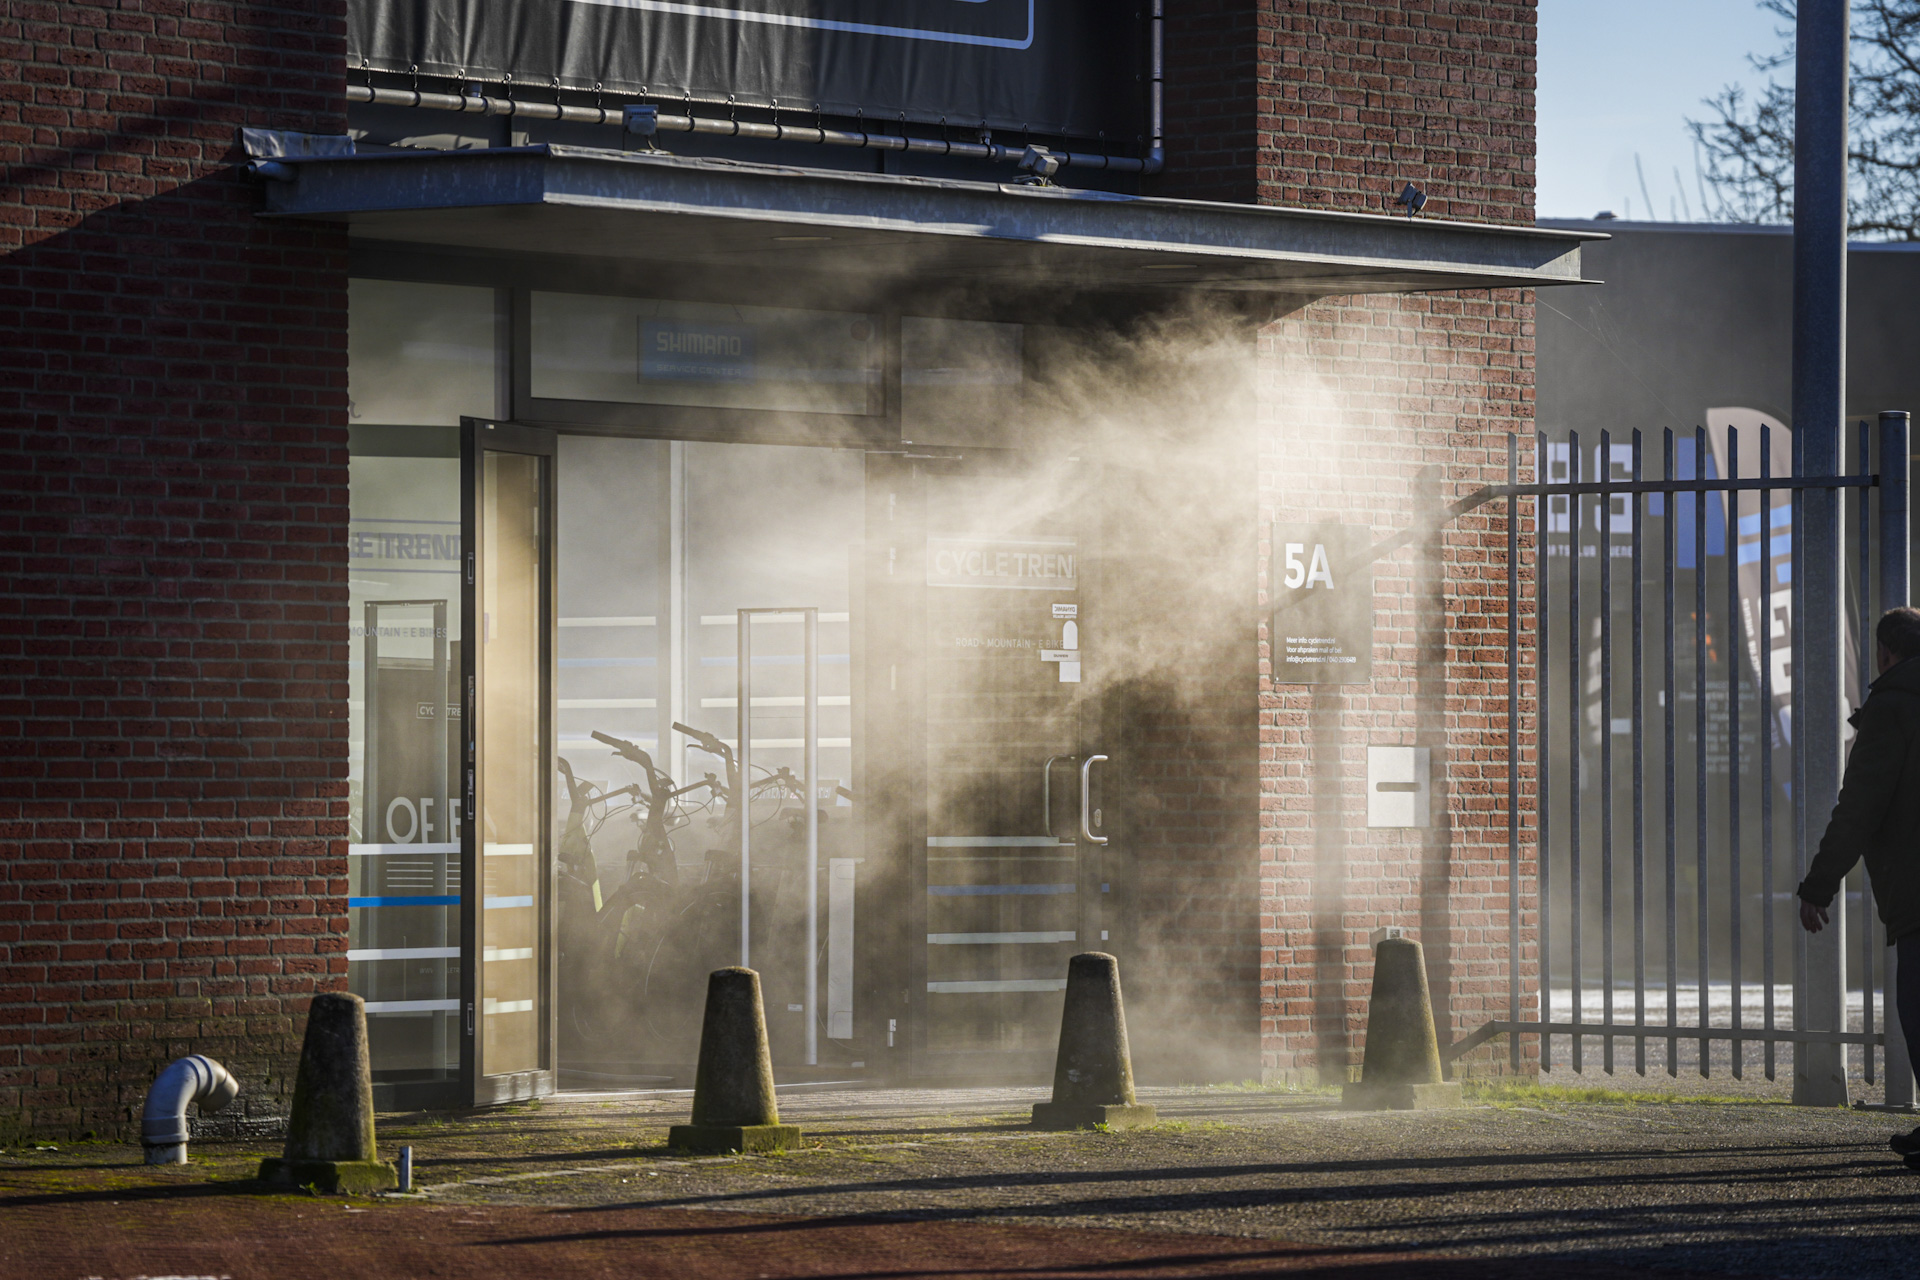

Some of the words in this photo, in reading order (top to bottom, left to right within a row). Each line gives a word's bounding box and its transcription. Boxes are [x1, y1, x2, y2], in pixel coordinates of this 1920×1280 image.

[656, 331, 742, 357] SHIMANO
[656, 364, 697, 374] SERVICE
[699, 366, 742, 377] CENTER
[935, 551, 1009, 577] CYCLE
[1284, 542, 1335, 590] 5A
[955, 637, 980, 648] ROAD
[987, 638, 1031, 649] MOUNTAIN
[1038, 639, 1044, 649] E
[1045, 639, 1064, 649] BIKE
[1286, 636, 1298, 644] Meer
[1308, 637, 1336, 646] cycletrend.nl
[1297, 646, 1319, 654] afspraken
